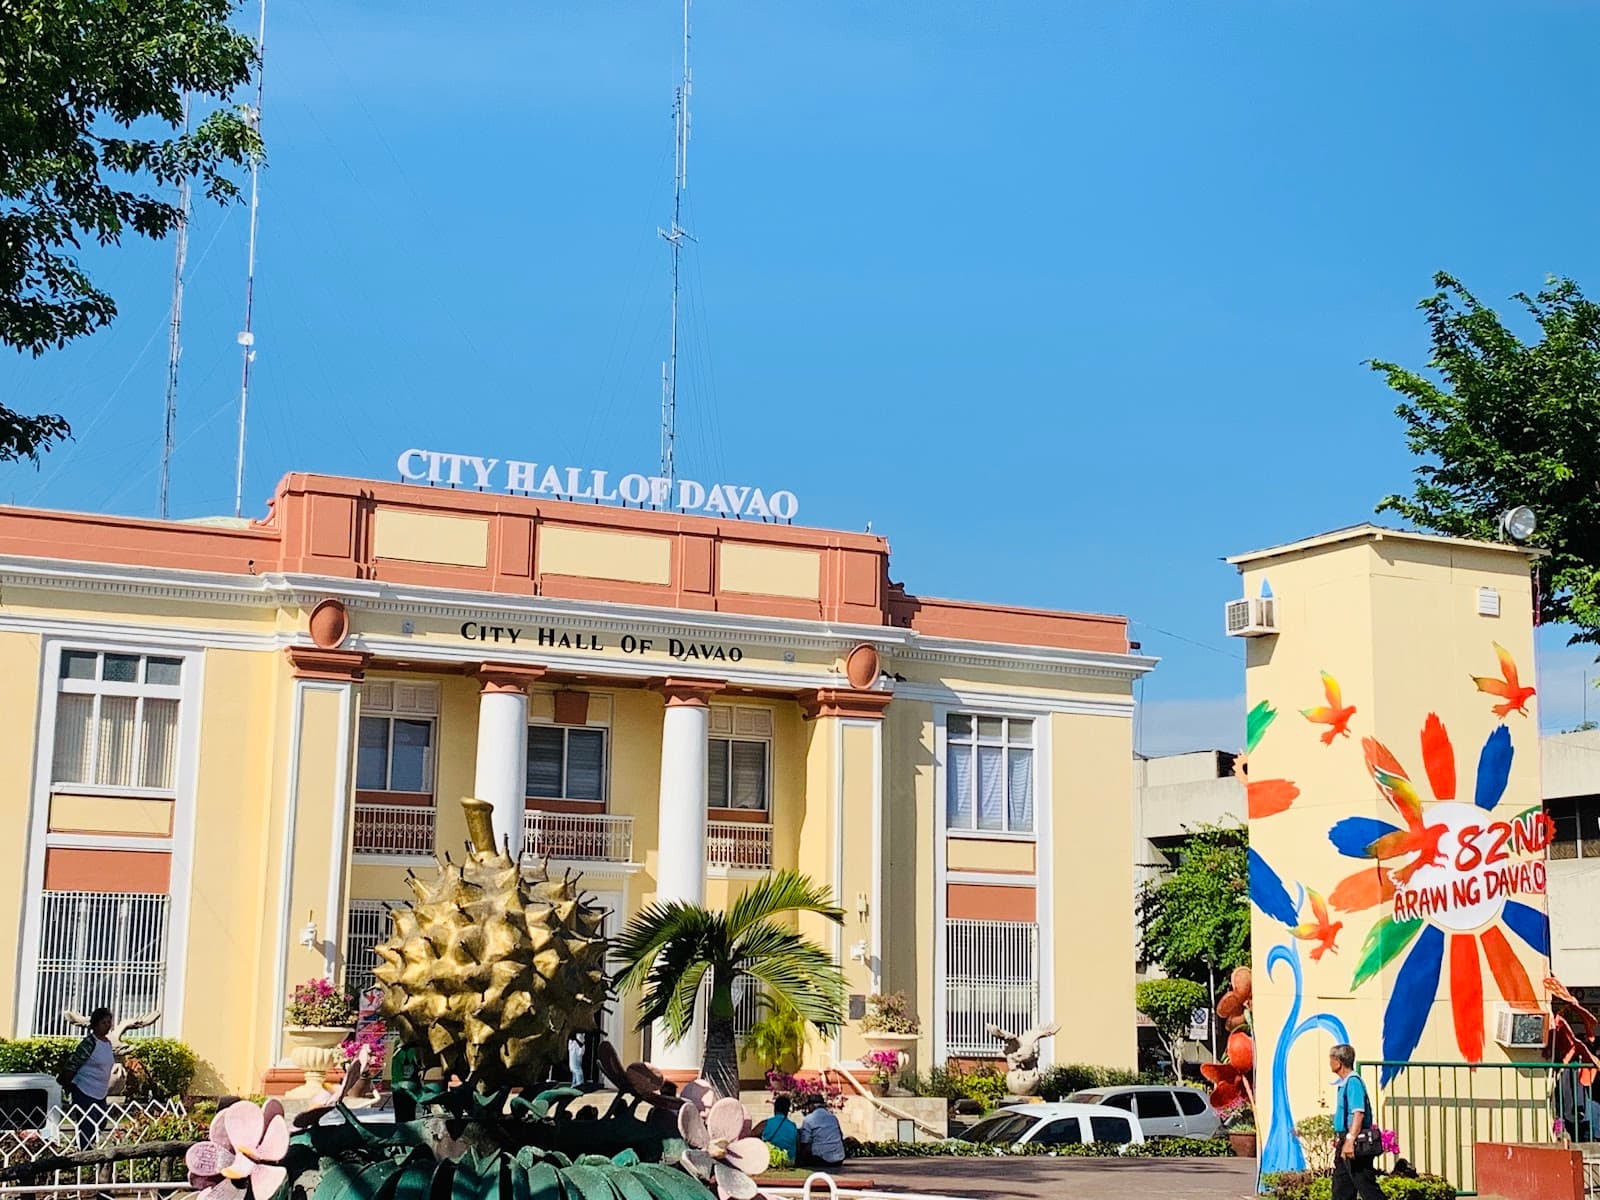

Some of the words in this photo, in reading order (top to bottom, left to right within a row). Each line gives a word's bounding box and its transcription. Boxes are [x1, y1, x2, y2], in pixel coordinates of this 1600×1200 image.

[397, 448, 499, 487] CITY
[505, 460, 617, 500] HALL
[619, 474, 671, 506] OF
[675, 479, 799, 519] DAVAO
[460, 621, 522, 644] CITY
[538, 627, 604, 651] HALL
[620, 634, 654, 655] OF
[668, 638, 744, 663] DAVAO
[1455, 813, 1550, 872] 82ND
[1394, 884, 1448, 920] ARAW
[1452, 875, 1480, 910] NG
[1483, 861, 1546, 900] DAVAO
